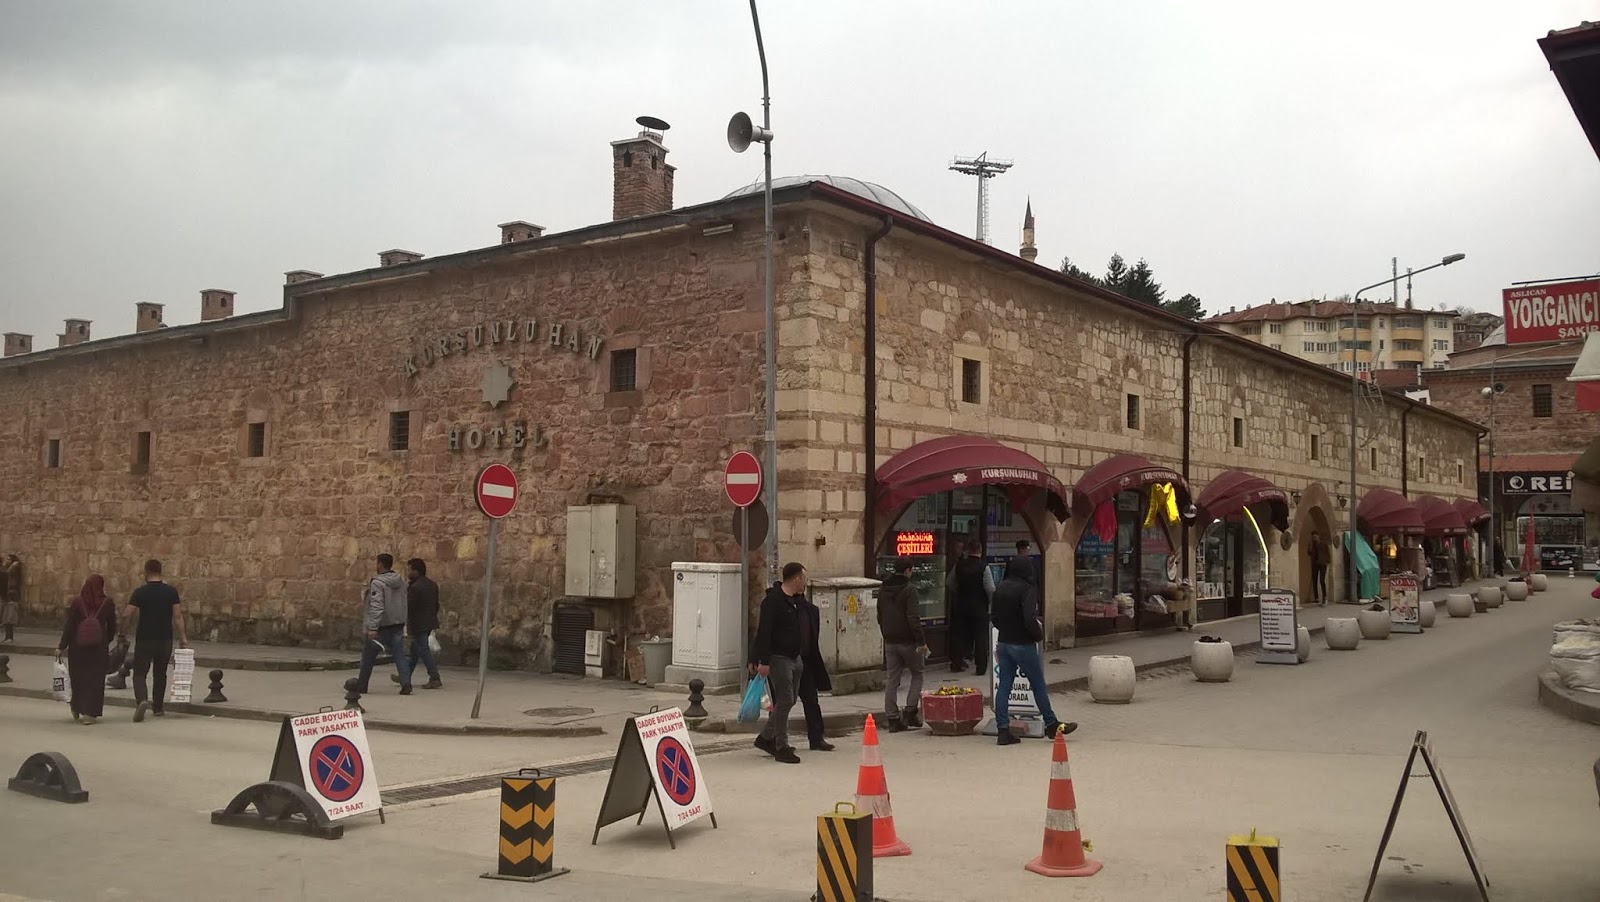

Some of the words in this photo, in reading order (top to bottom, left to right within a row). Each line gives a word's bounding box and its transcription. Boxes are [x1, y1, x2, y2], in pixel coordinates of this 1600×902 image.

[1510, 289, 1546, 298] ASLICAN
[1508, 292, 1599, 329] YORGANCI
[447, 425, 544, 449] HOTEL
[294, 716, 320, 727] CADDE
[322, 710, 359, 723] BOYUNCA
[657, 710, 682, 723] BOYUNCA
[298, 728, 318, 737] PARK
[320, 720, 359, 733] YASAKTIR
[642, 729, 658, 739] PARK
[657, 721, 684, 735] YASAKTIR
[328, 807, 344, 816] 7/24
[345, 802, 364, 812] SAAT
[689, 805, 701, 817] SAAT
